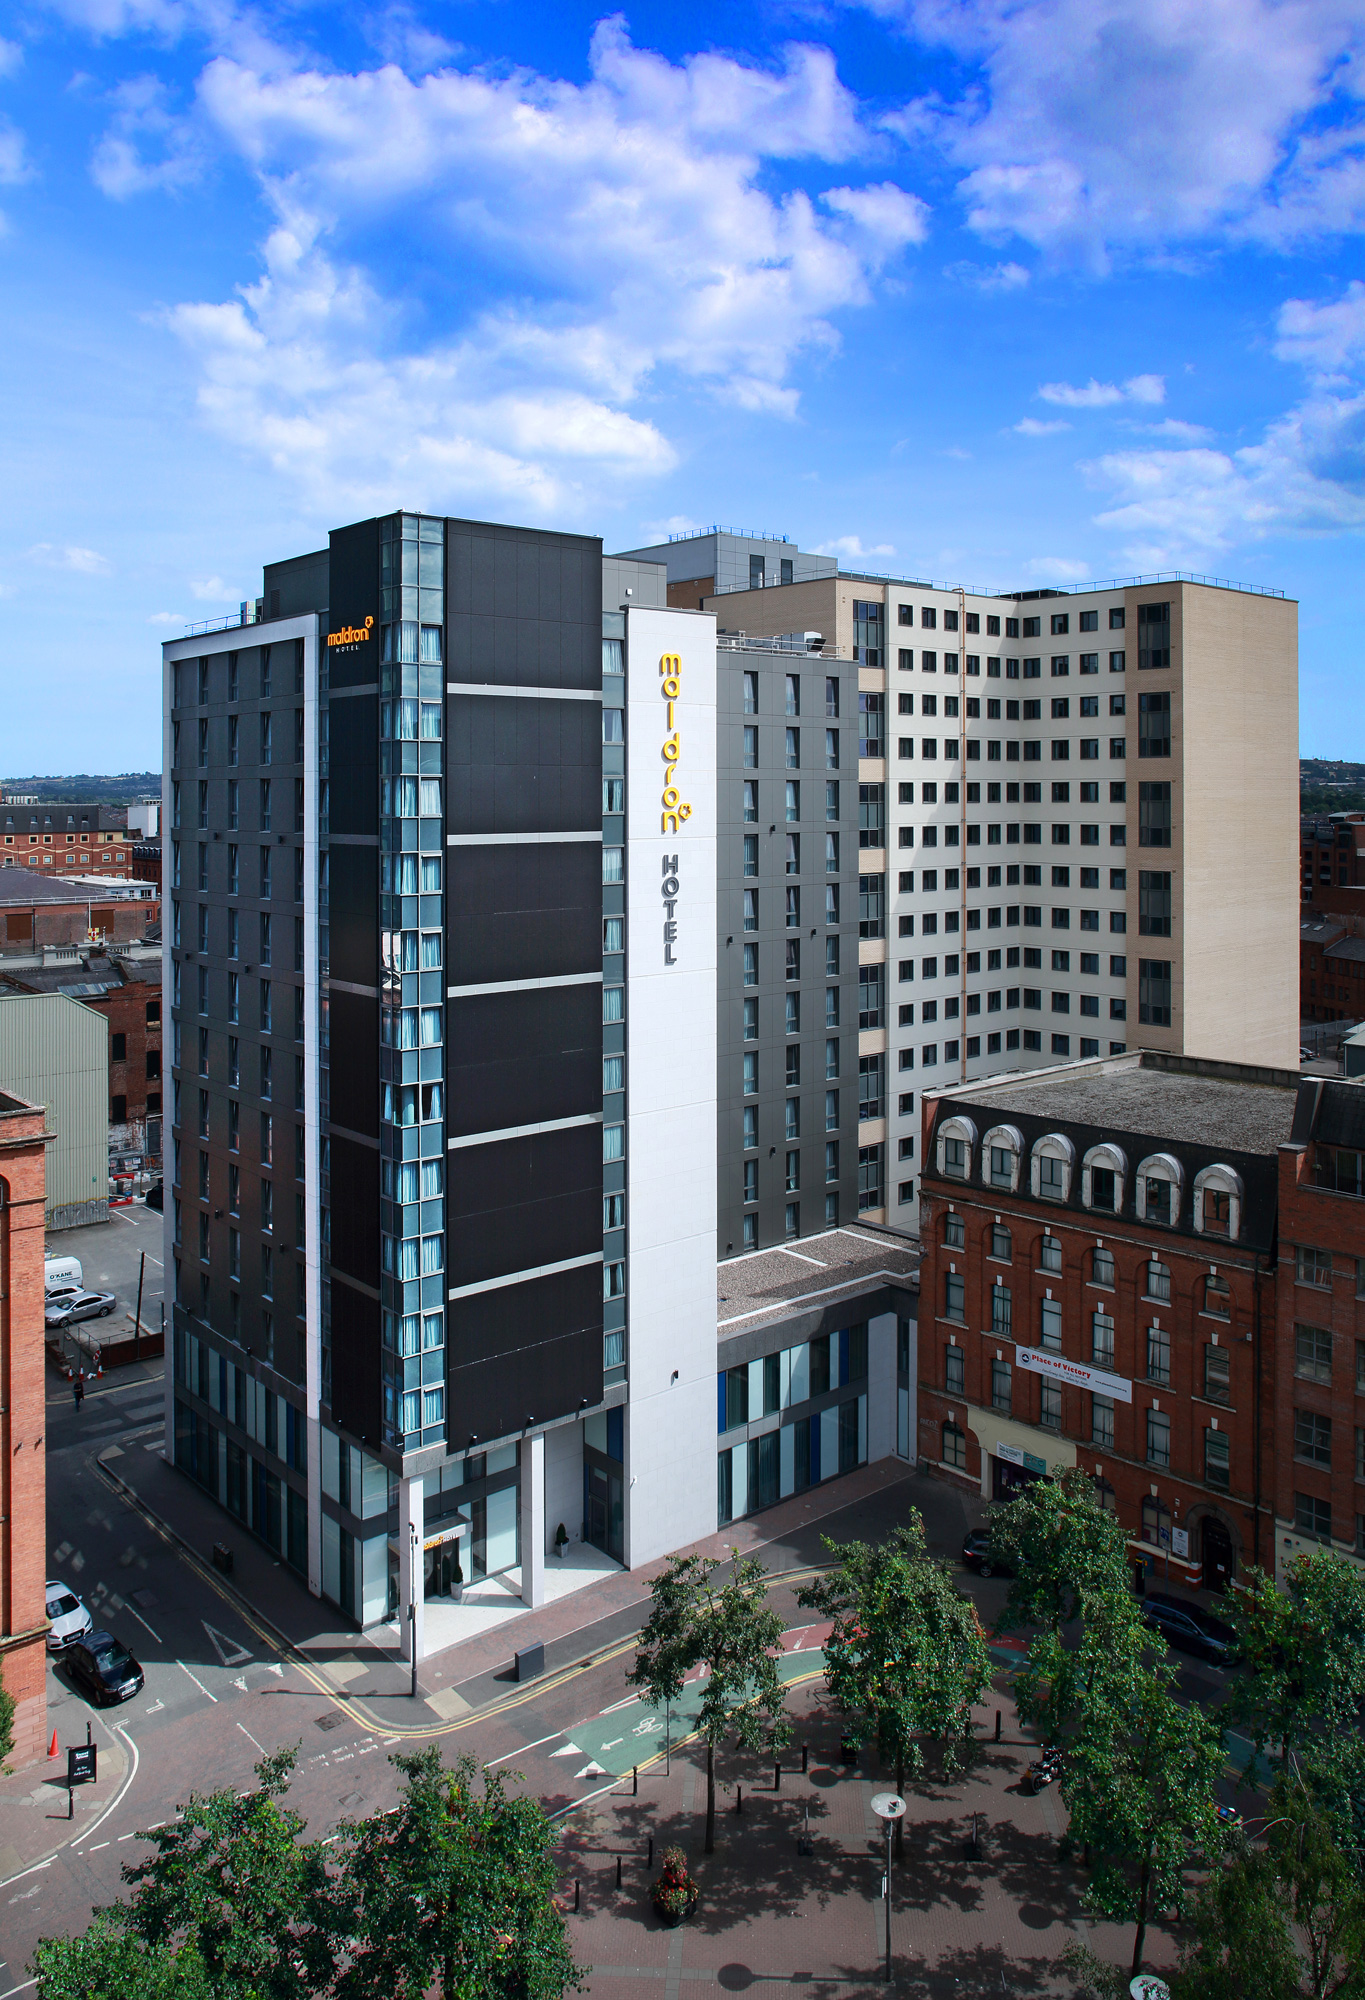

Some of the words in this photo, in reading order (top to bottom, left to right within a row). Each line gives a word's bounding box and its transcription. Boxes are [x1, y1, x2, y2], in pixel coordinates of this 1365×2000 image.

[328, 626, 369, 646] maldron
[335, 645, 360, 653] HOTEL
[661, 653, 682, 831] maldron
[662, 854, 680, 965] HOTEL
[1031, 1354, 1052, 1367] Place
[1053, 1361, 1062, 1369] of
[1062, 1364, 1091, 1379] Victory
